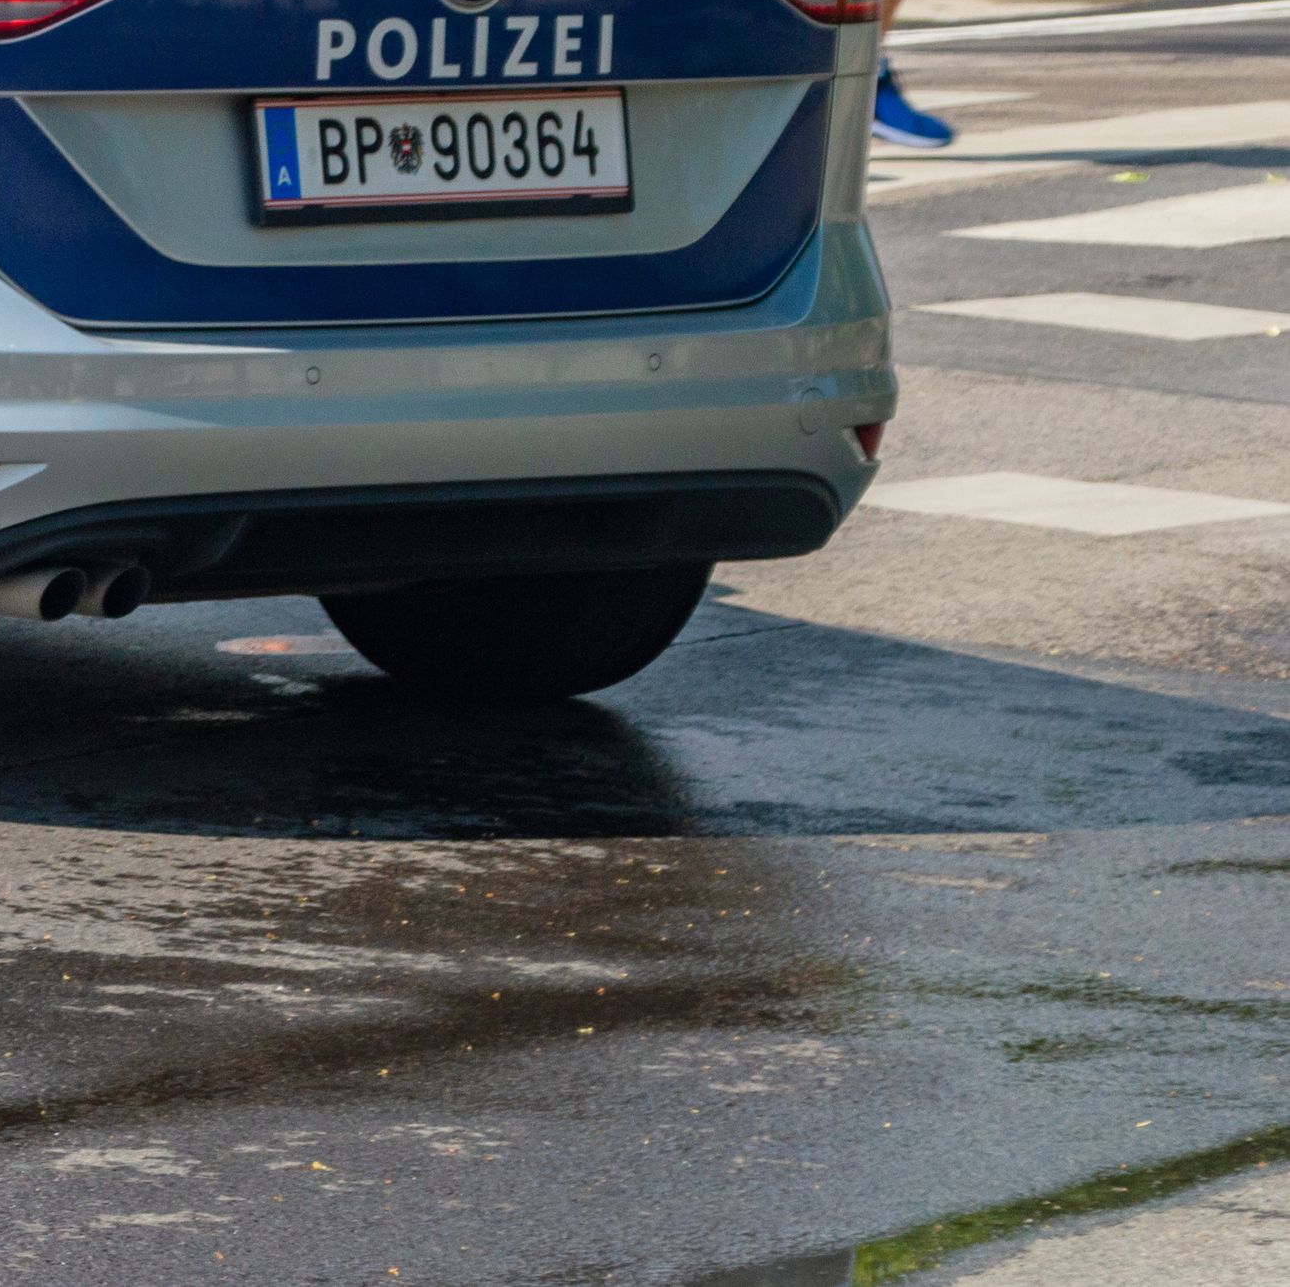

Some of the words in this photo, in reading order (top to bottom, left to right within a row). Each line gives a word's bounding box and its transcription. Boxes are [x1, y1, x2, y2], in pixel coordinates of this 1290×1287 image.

[316, 14, 615, 81] POLIZEI
[277, 165, 292, 186] A
[430, 110, 600, 181] 90364
